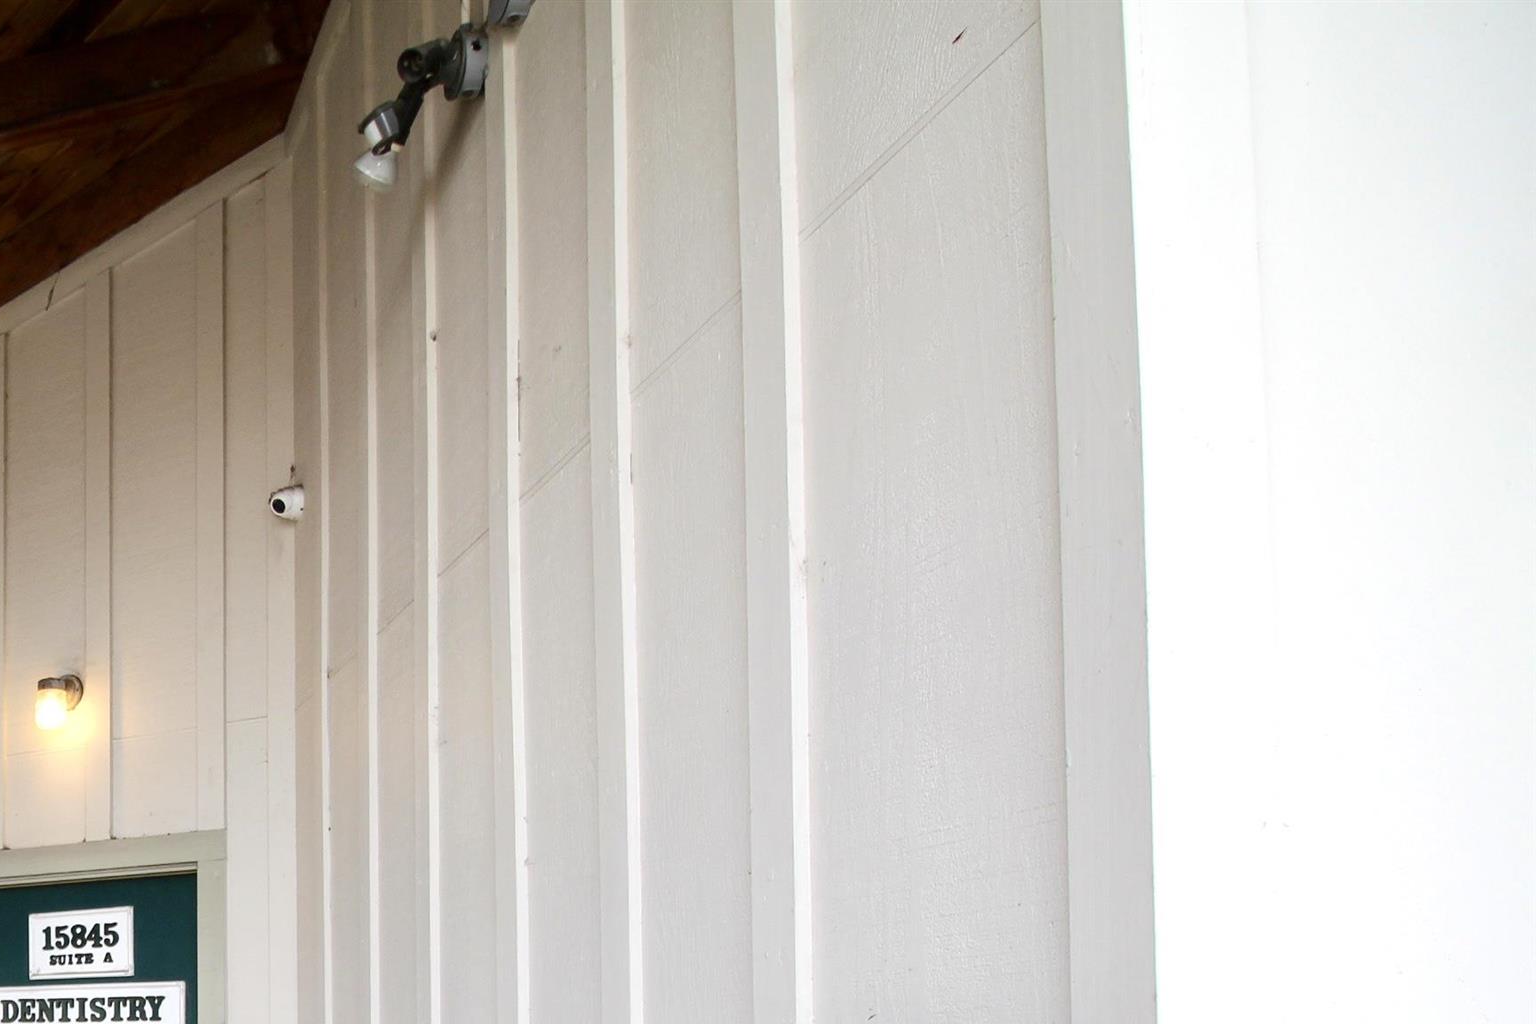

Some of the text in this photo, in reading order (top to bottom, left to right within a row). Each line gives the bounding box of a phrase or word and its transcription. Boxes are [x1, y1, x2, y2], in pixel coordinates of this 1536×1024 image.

[42, 922, 120, 950] 15845
[49, 952, 114, 966] SUITE A
[0, 995, 166, 1023] DENTISTRY
